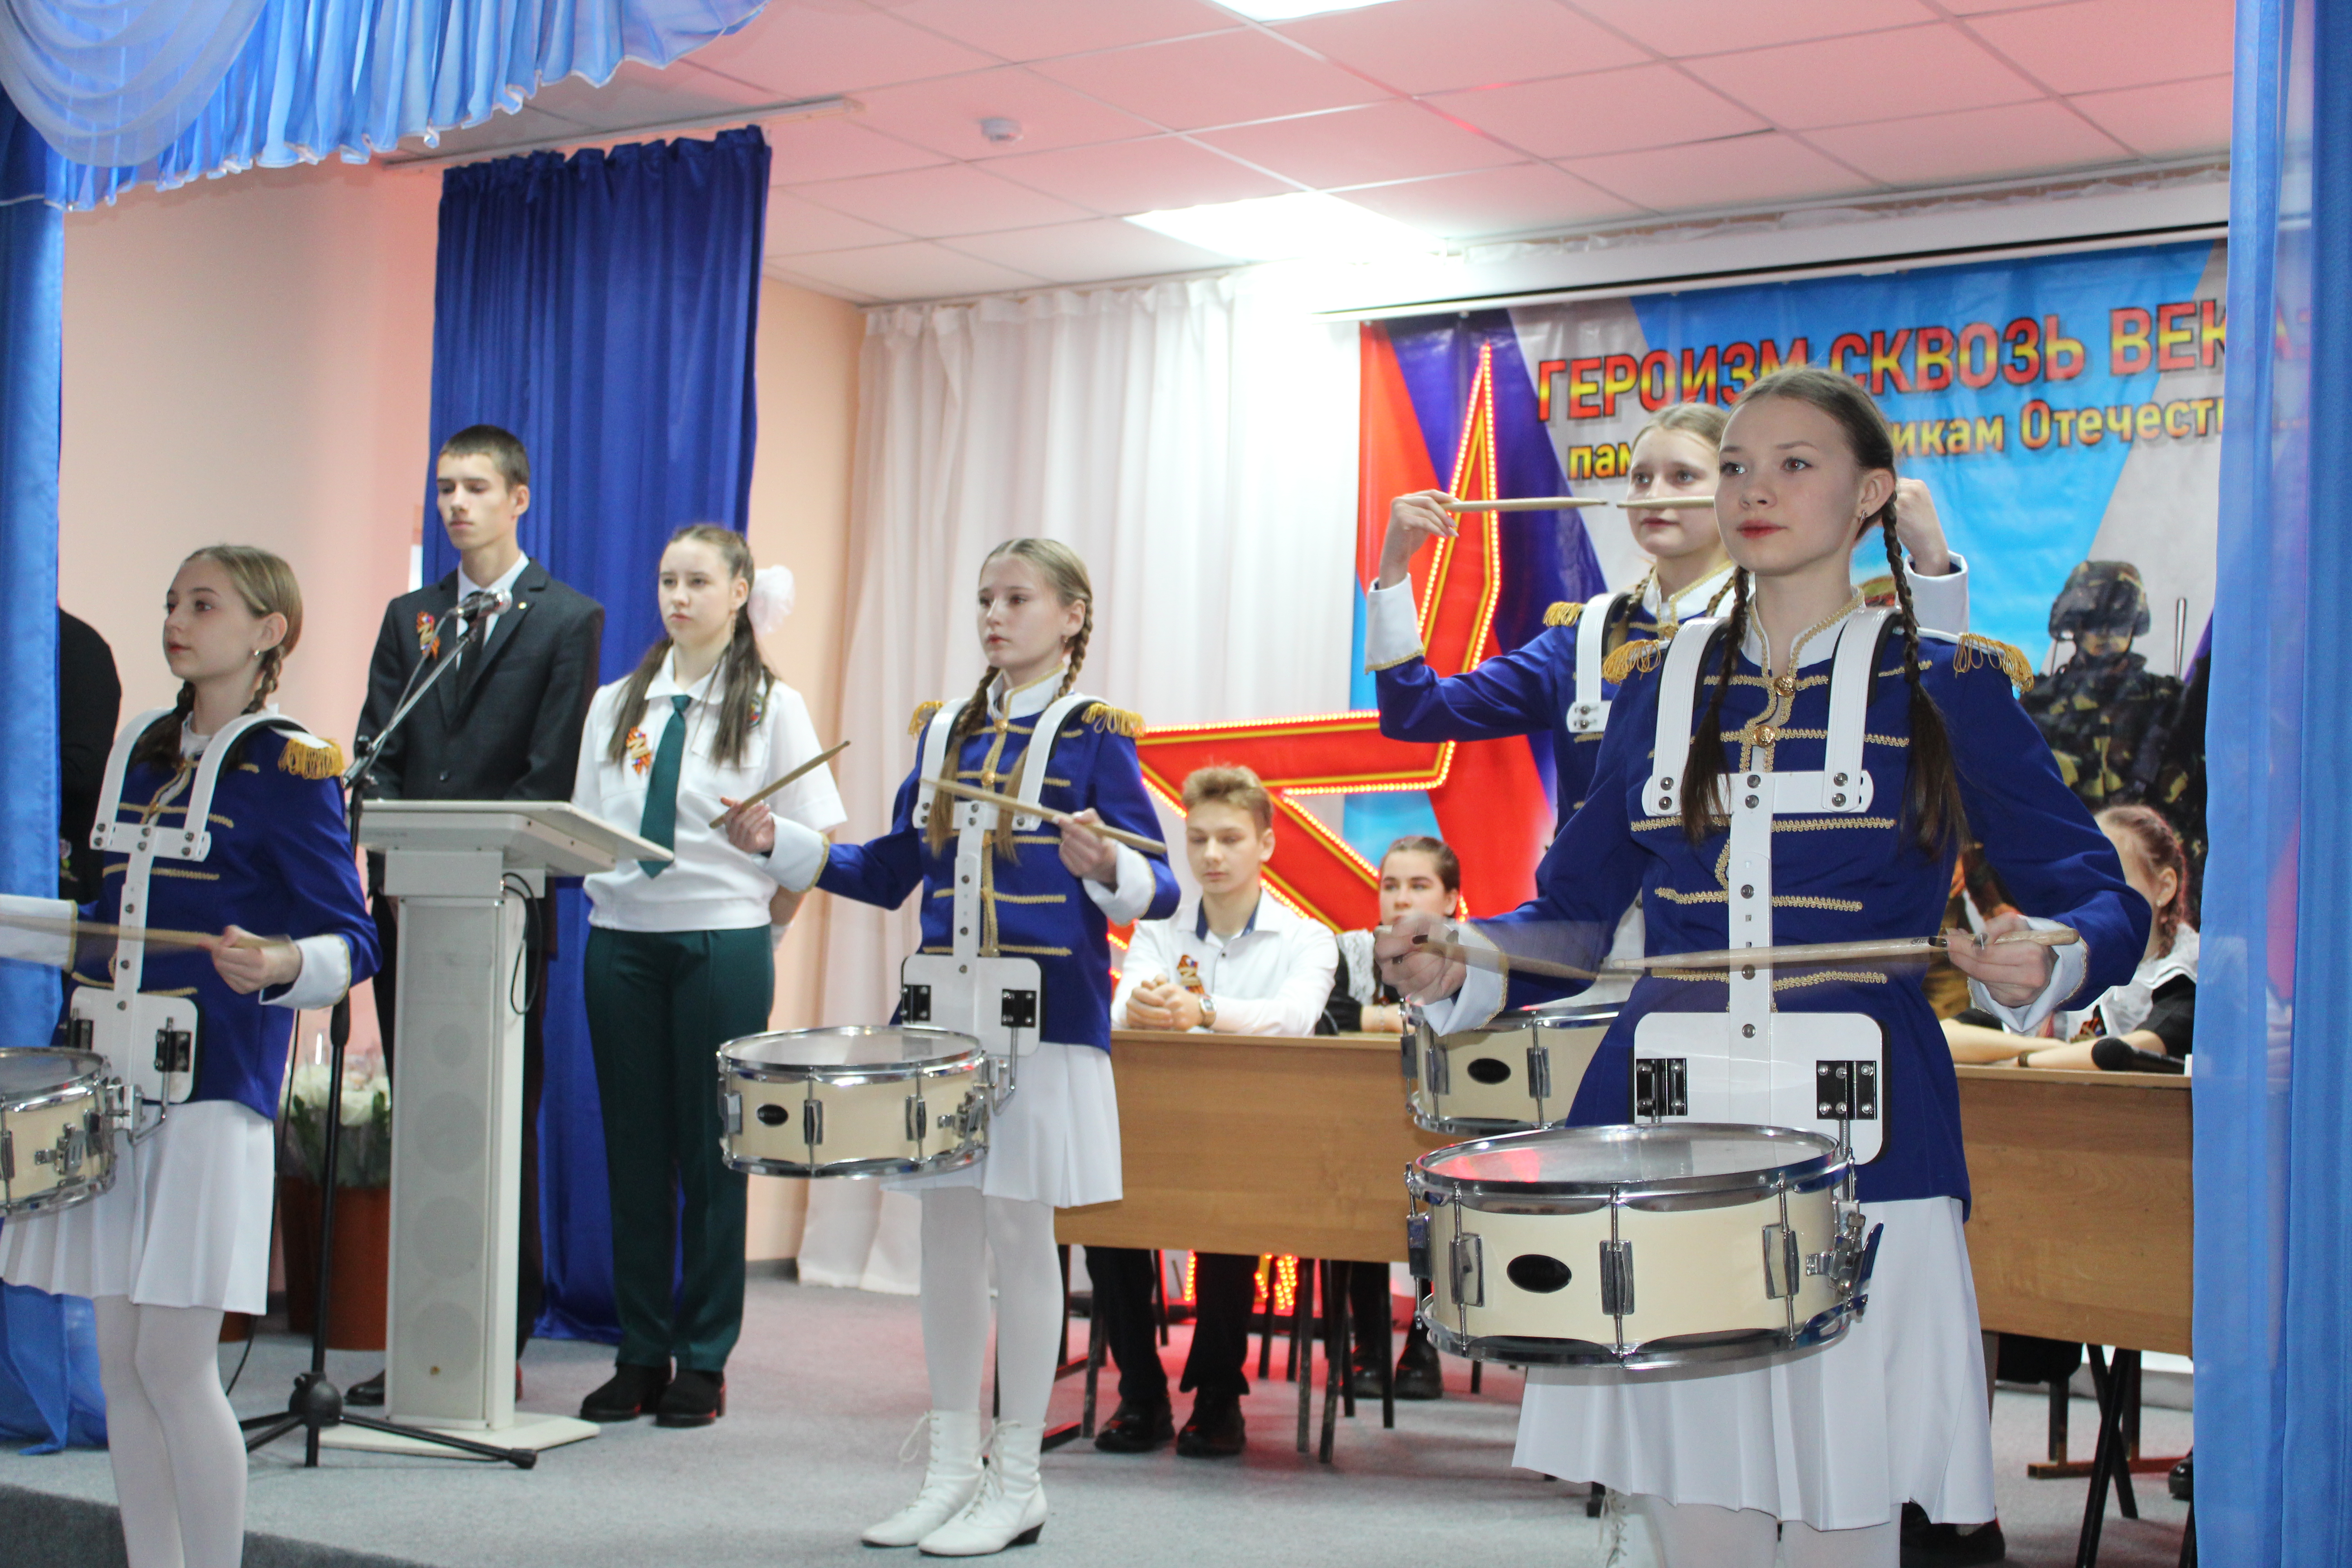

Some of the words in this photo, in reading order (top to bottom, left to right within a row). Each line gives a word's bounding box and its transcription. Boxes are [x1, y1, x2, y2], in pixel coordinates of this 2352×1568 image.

[1537, 337, 1808, 421] ГЕРОИЗМ
[1829, 314, 2086, 396] СКВОЗЬ
[1891, 415, 2004, 456] икам
[2020, 395, 2224, 450] Отечест
